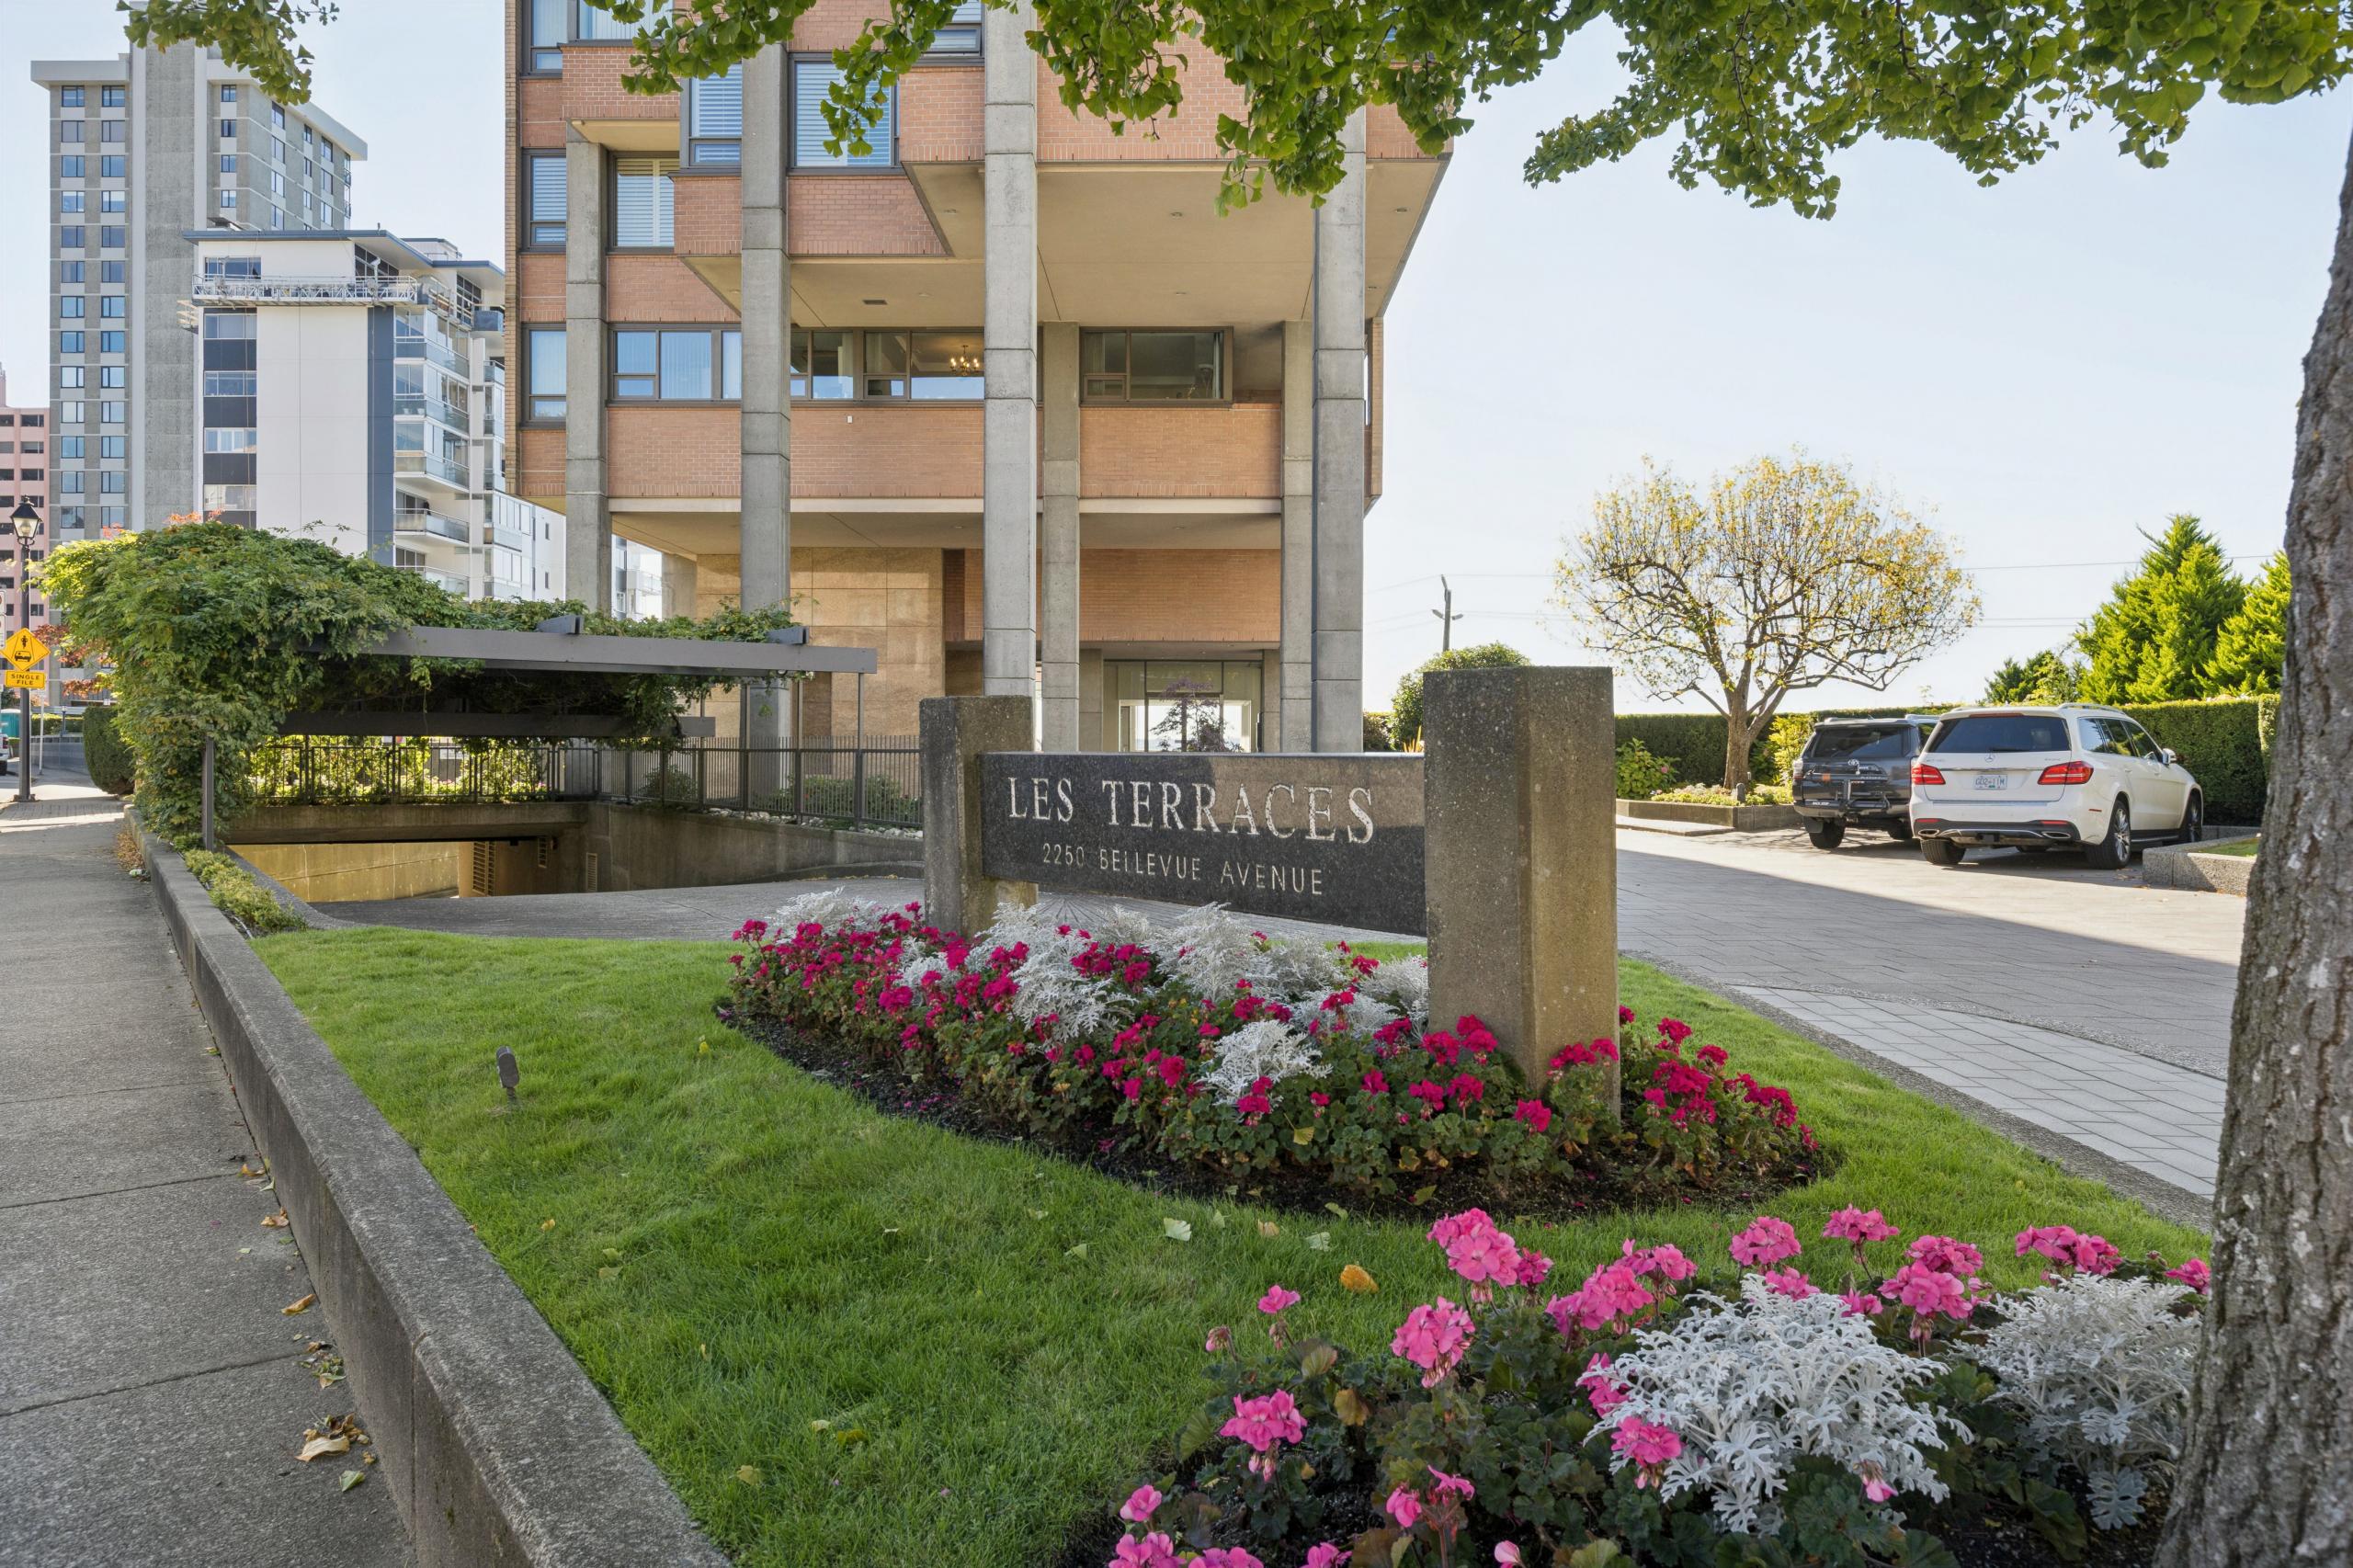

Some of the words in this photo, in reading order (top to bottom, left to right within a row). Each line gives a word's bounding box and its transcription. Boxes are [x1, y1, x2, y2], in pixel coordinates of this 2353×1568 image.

[1008, 777, 1074, 823] LES
[1102, 779, 1374, 844] TERRACES
[1043, 843, 1085, 868] 2250
[1099, 848, 1202, 881] BELLEVUE
[1221, 860, 1322, 894] AVENUE
